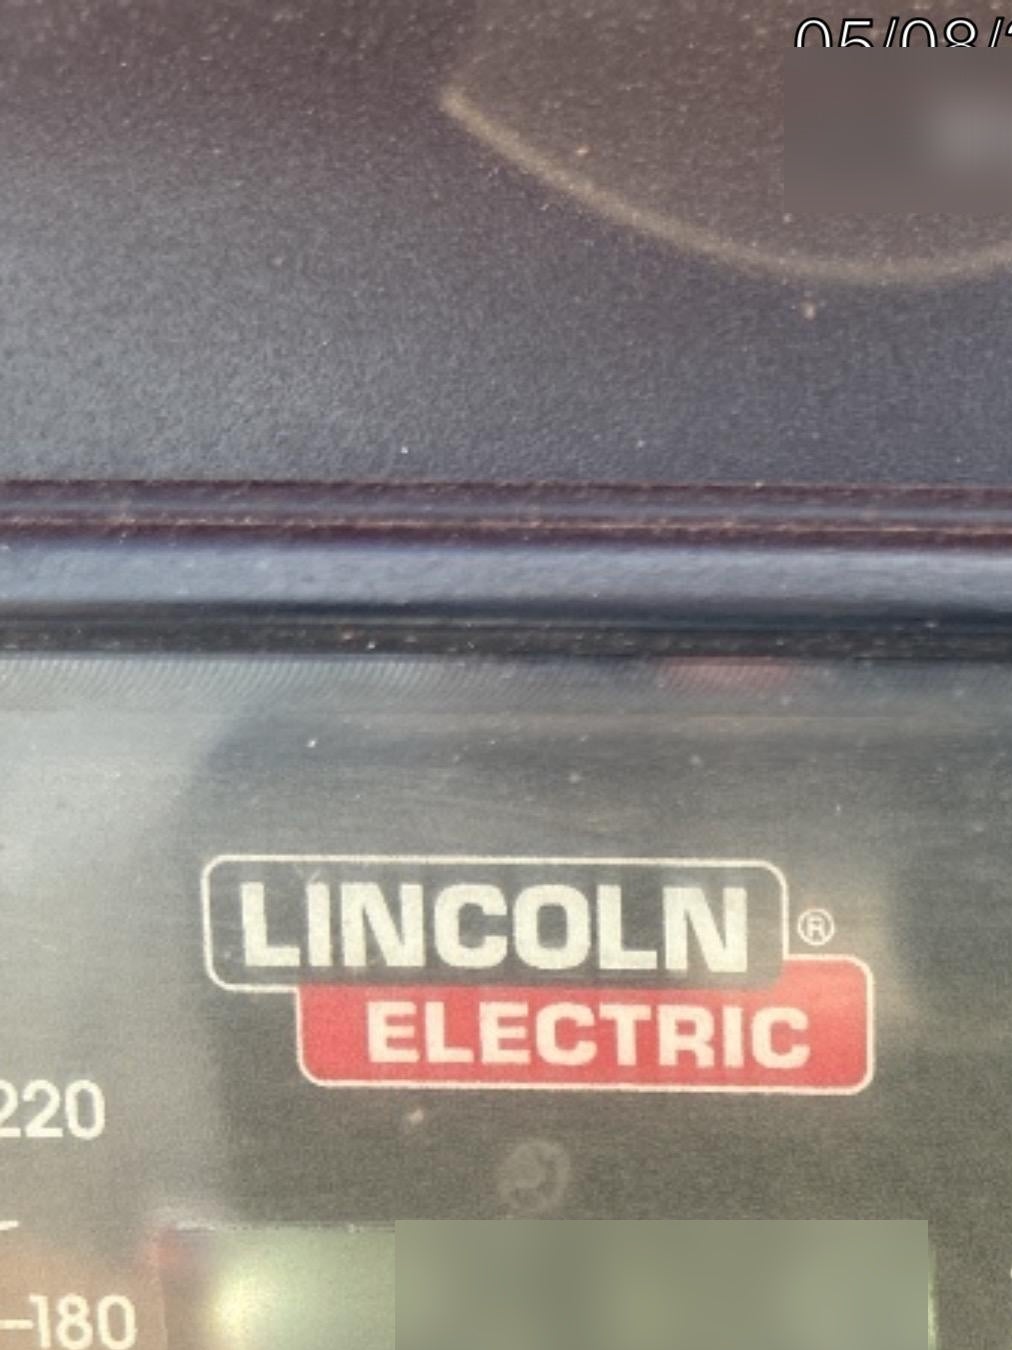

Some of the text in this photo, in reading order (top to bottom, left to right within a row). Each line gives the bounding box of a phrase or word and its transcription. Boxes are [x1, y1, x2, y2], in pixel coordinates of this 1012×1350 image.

[240, 881, 748, 972] LINCOLN
[366, 1001, 810, 1069] ELECTRIC
[29, 1294, 137, 1350] 180
